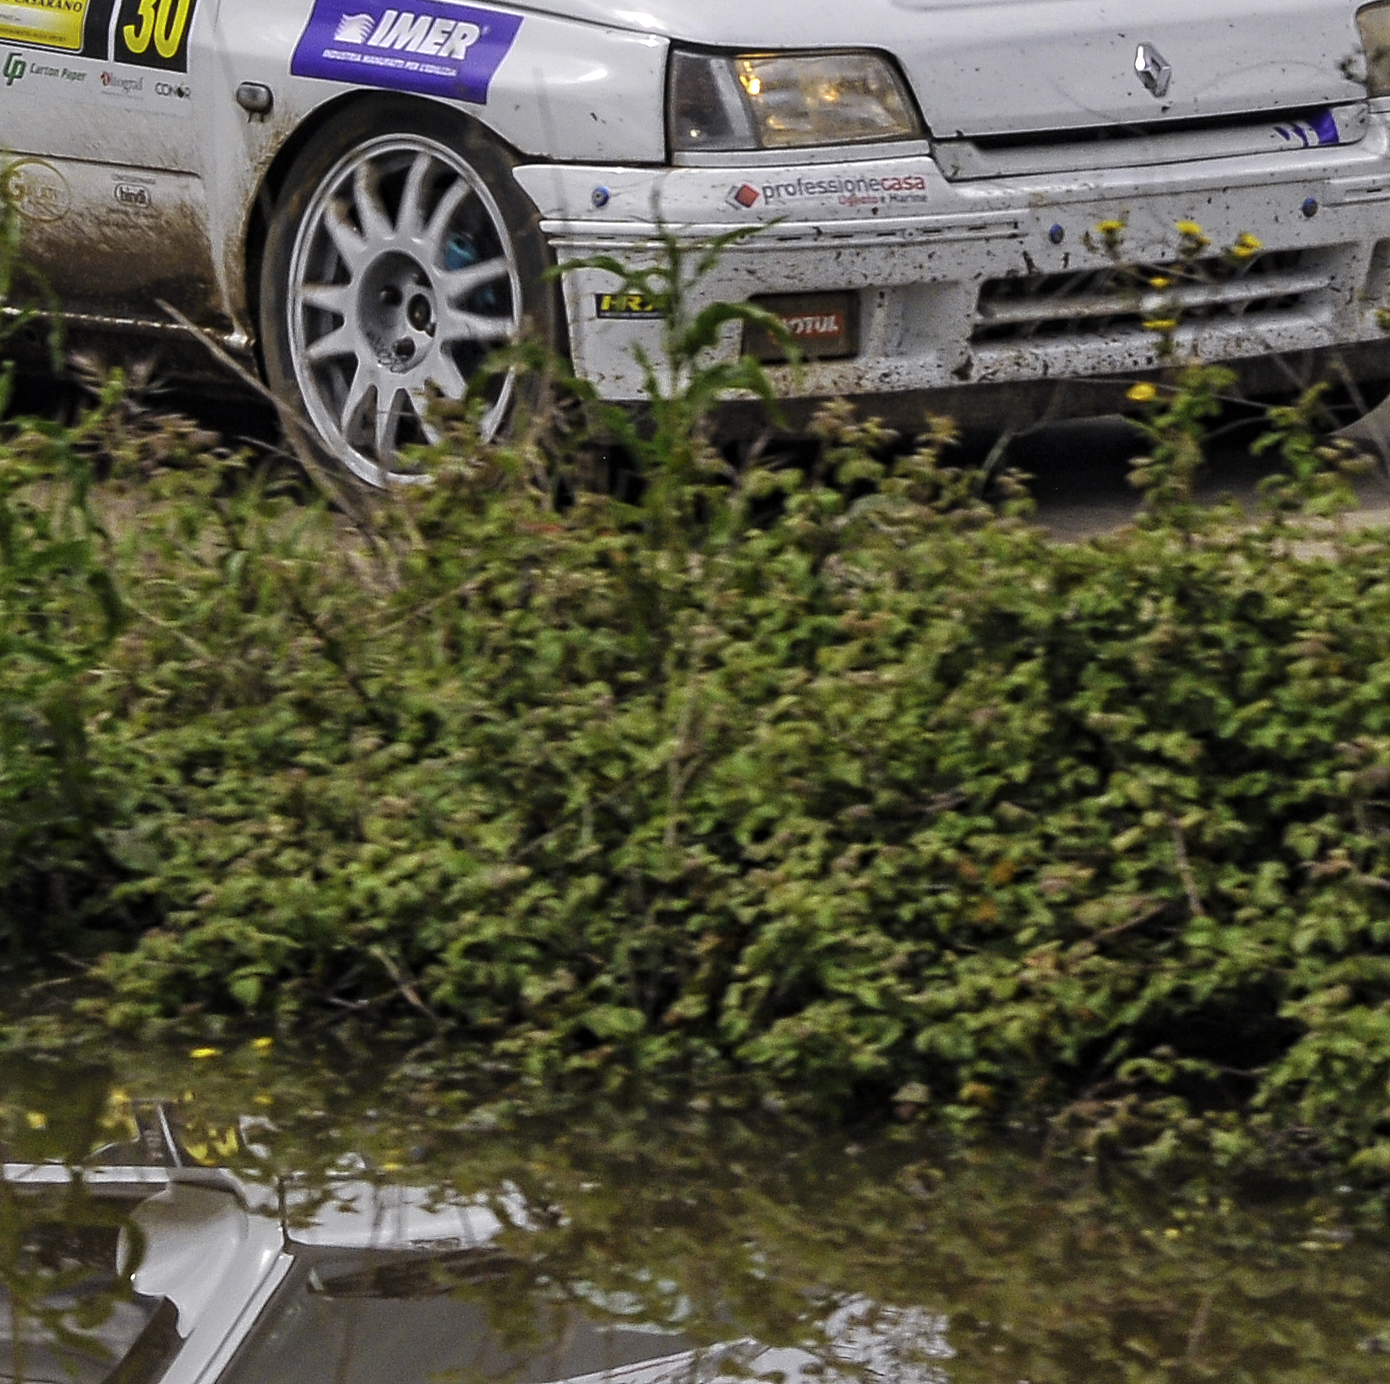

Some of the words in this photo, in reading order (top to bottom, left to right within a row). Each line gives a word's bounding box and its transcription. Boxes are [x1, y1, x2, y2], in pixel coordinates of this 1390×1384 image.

[367, 9, 481, 60] IMER
[61, 68, 88, 83] Paper
[762, 175, 926, 205] professionecasa
